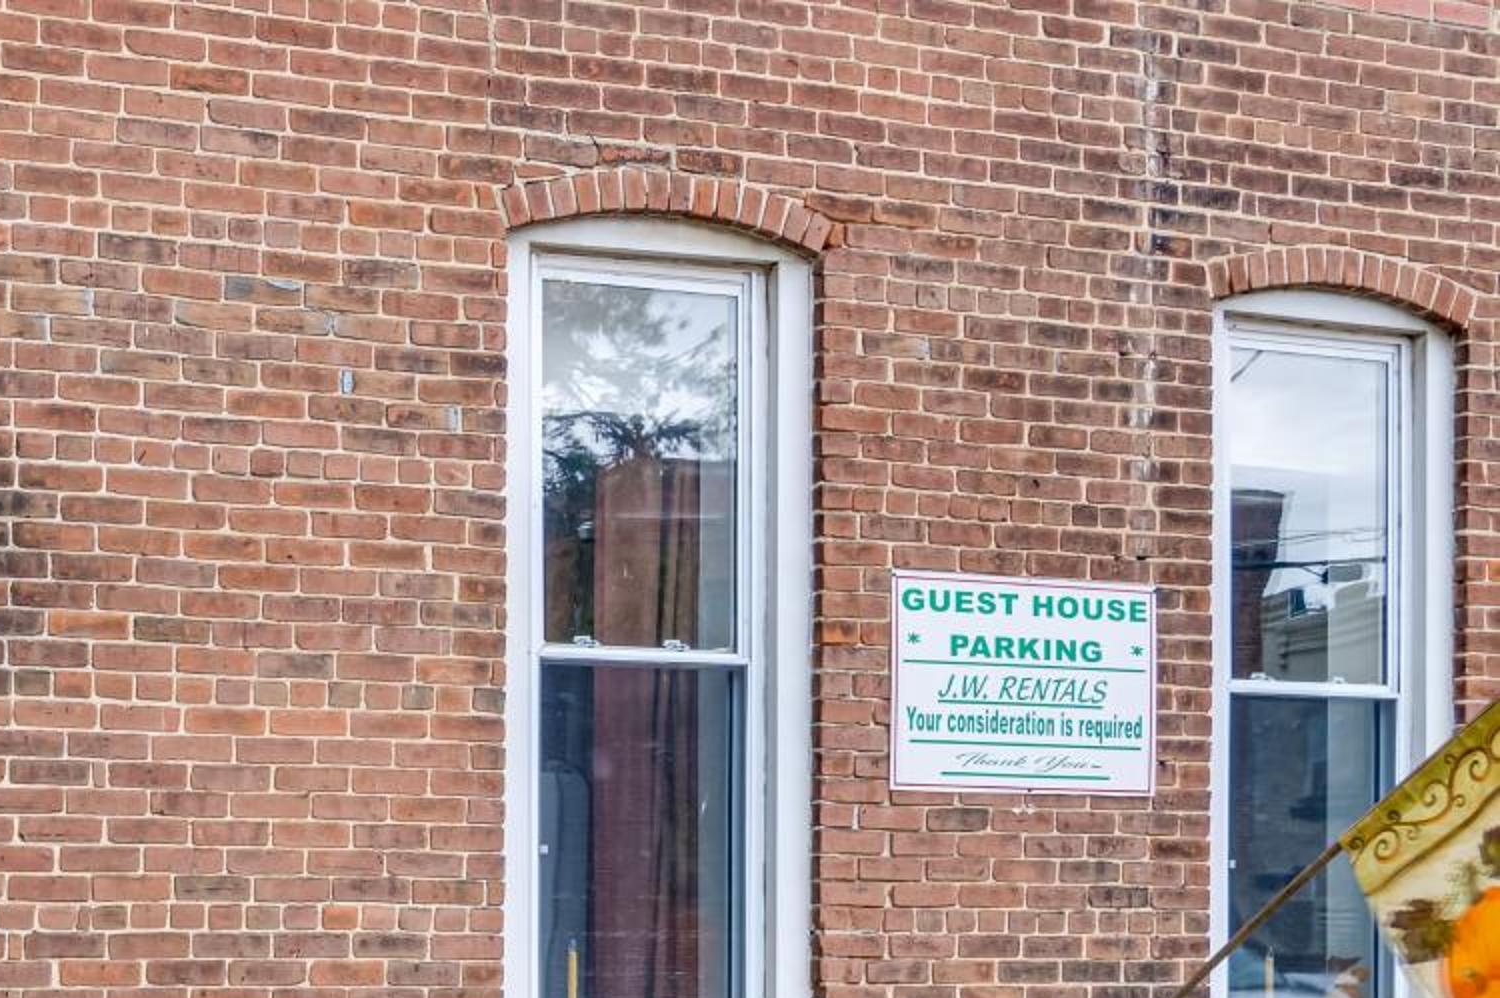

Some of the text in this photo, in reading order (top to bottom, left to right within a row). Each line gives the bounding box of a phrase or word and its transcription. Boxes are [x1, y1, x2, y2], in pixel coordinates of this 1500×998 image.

[902, 588, 1147, 623] GUEST HOUSE
[949, 634, 1103, 663] PARKING
[938, 673, 1108, 704] J.W. RENTALS
[906, 706, 1143, 744] Your consideration is required
[956, 751, 1026, 769] Thank
